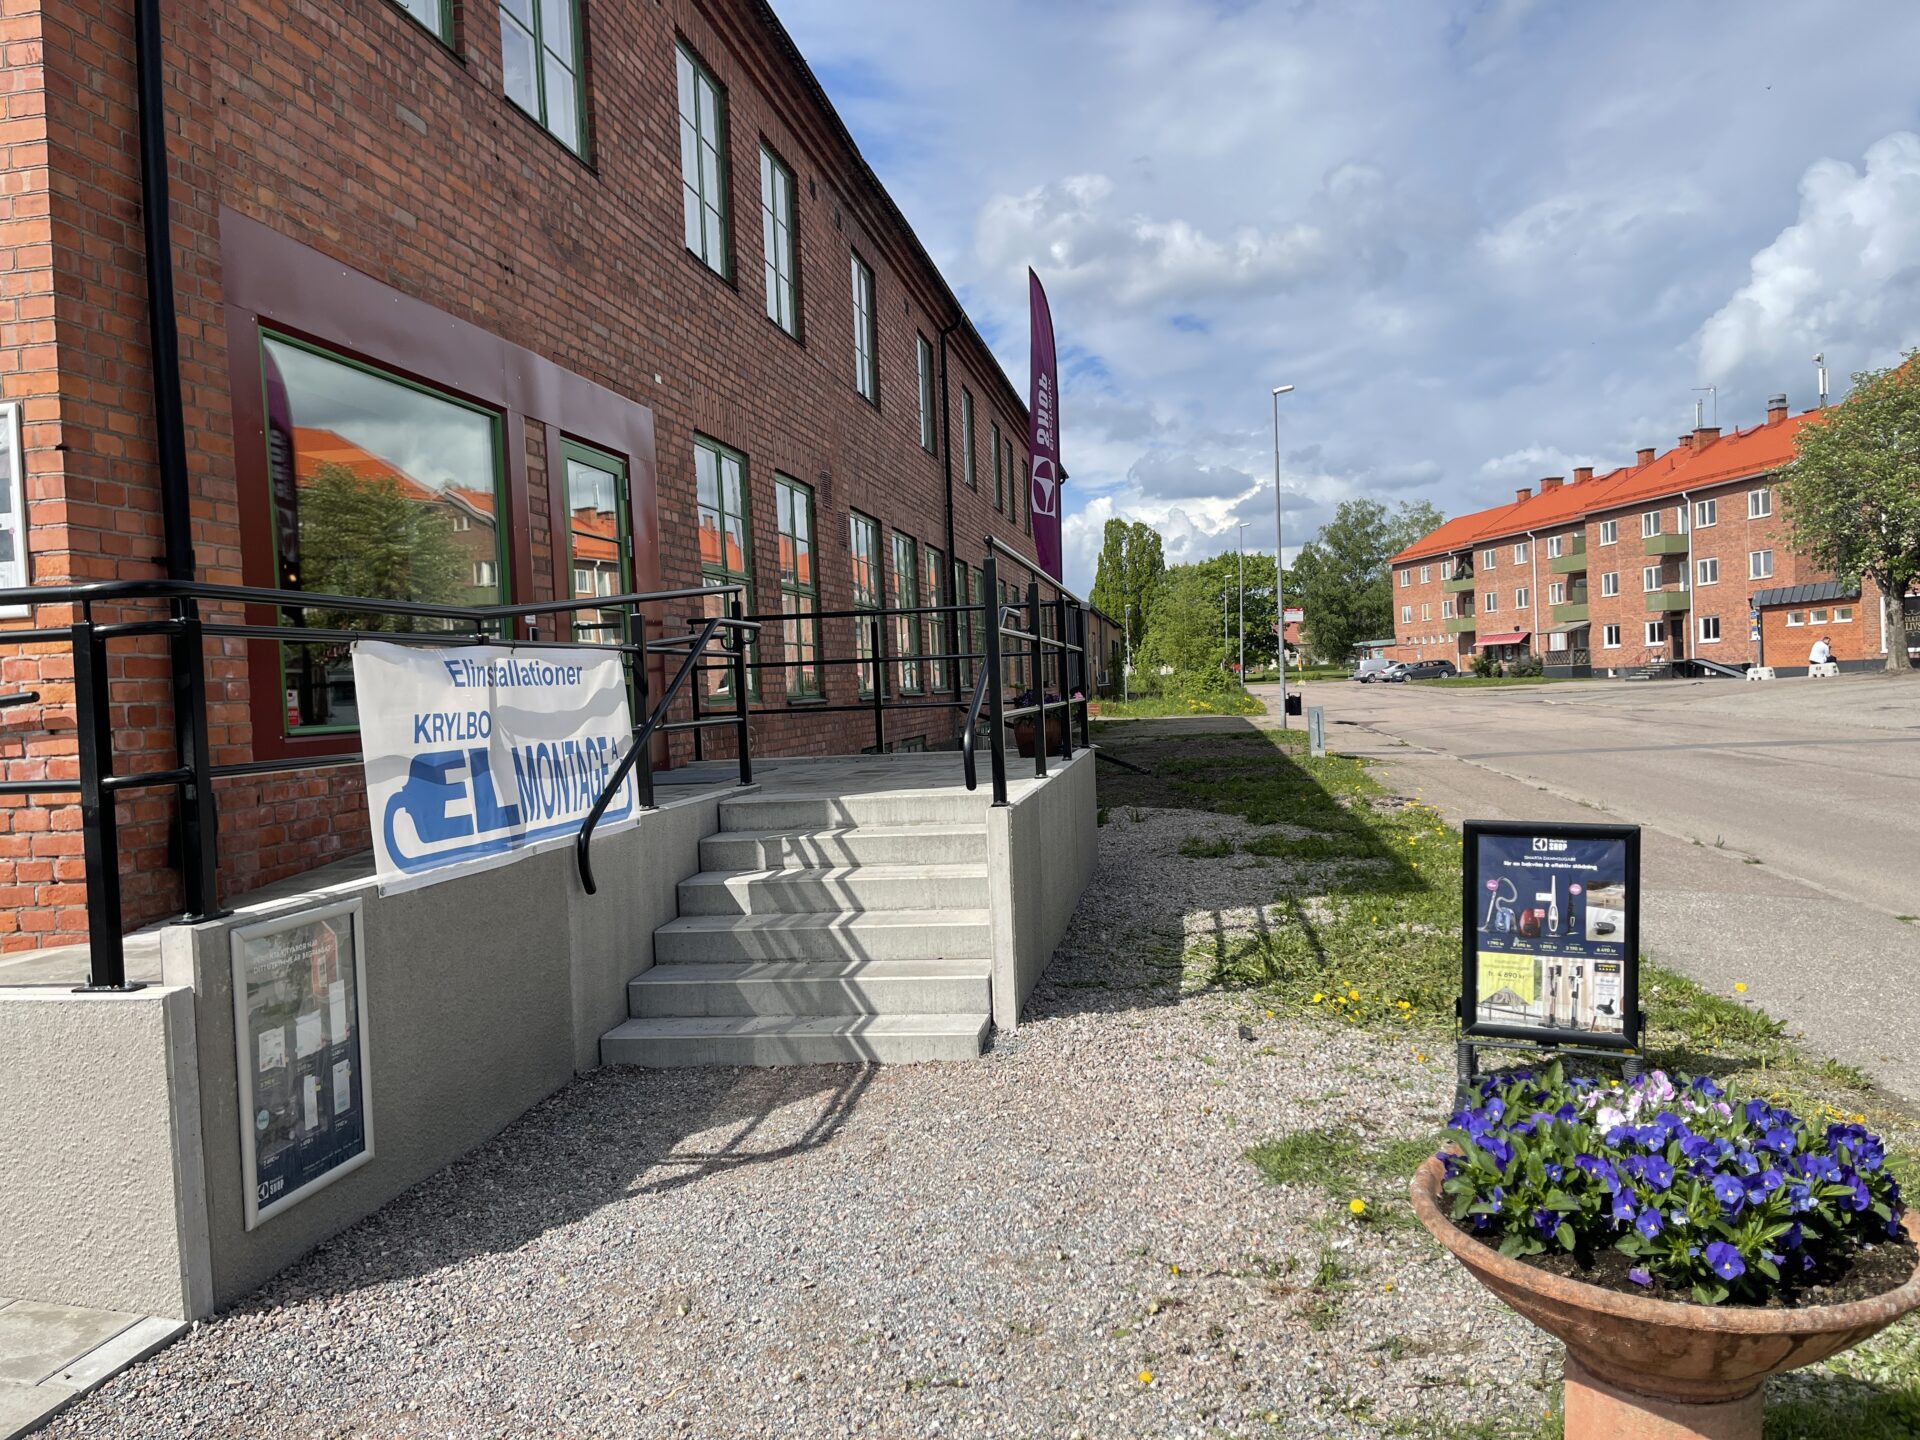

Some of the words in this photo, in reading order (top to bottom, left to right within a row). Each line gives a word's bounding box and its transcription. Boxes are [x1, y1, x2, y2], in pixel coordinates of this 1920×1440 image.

[444, 659, 583, 688] Elinstallationer
[414, 710, 492, 744] KRYLBO
[406, 747, 520, 844] EL
[511, 736, 610, 823] MONTAGE
